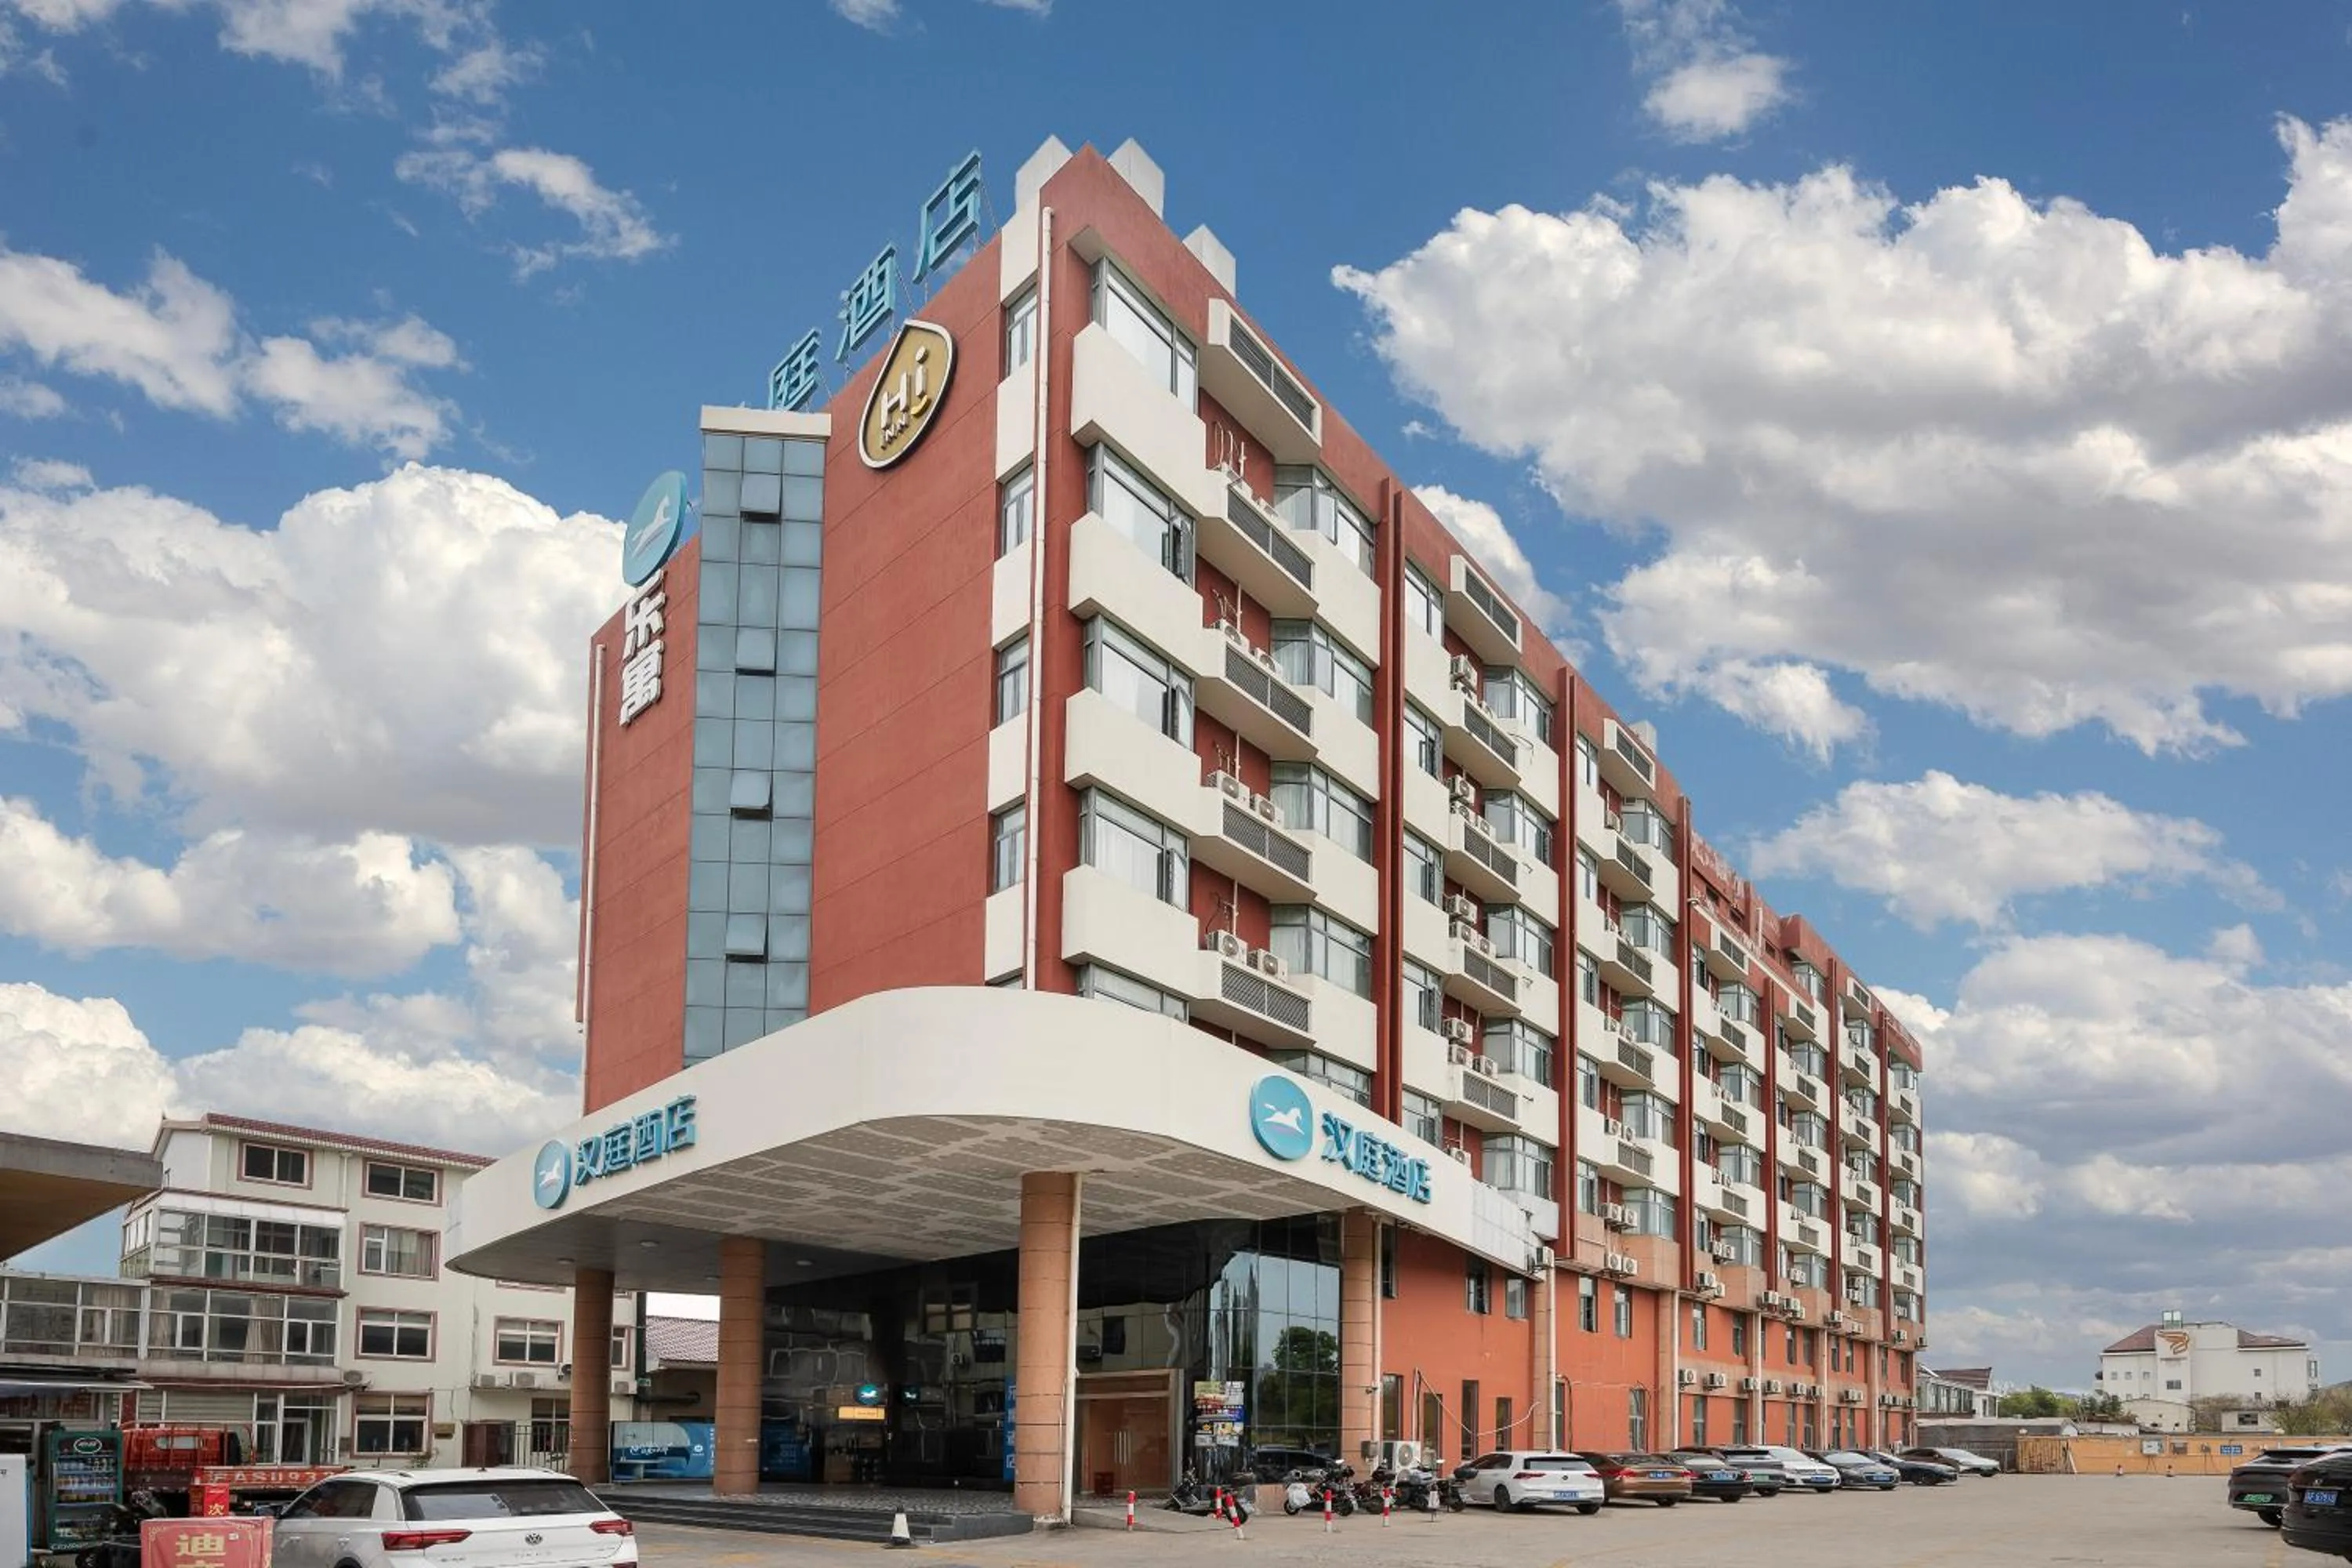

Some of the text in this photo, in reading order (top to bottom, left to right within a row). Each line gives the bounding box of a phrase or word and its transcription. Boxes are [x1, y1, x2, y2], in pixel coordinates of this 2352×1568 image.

[880, 345, 927, 430] Hi
[575, 1094, 696, 1185] 汉庭酒店
[1321, 1110, 1432, 1204] 汉庭酒店
